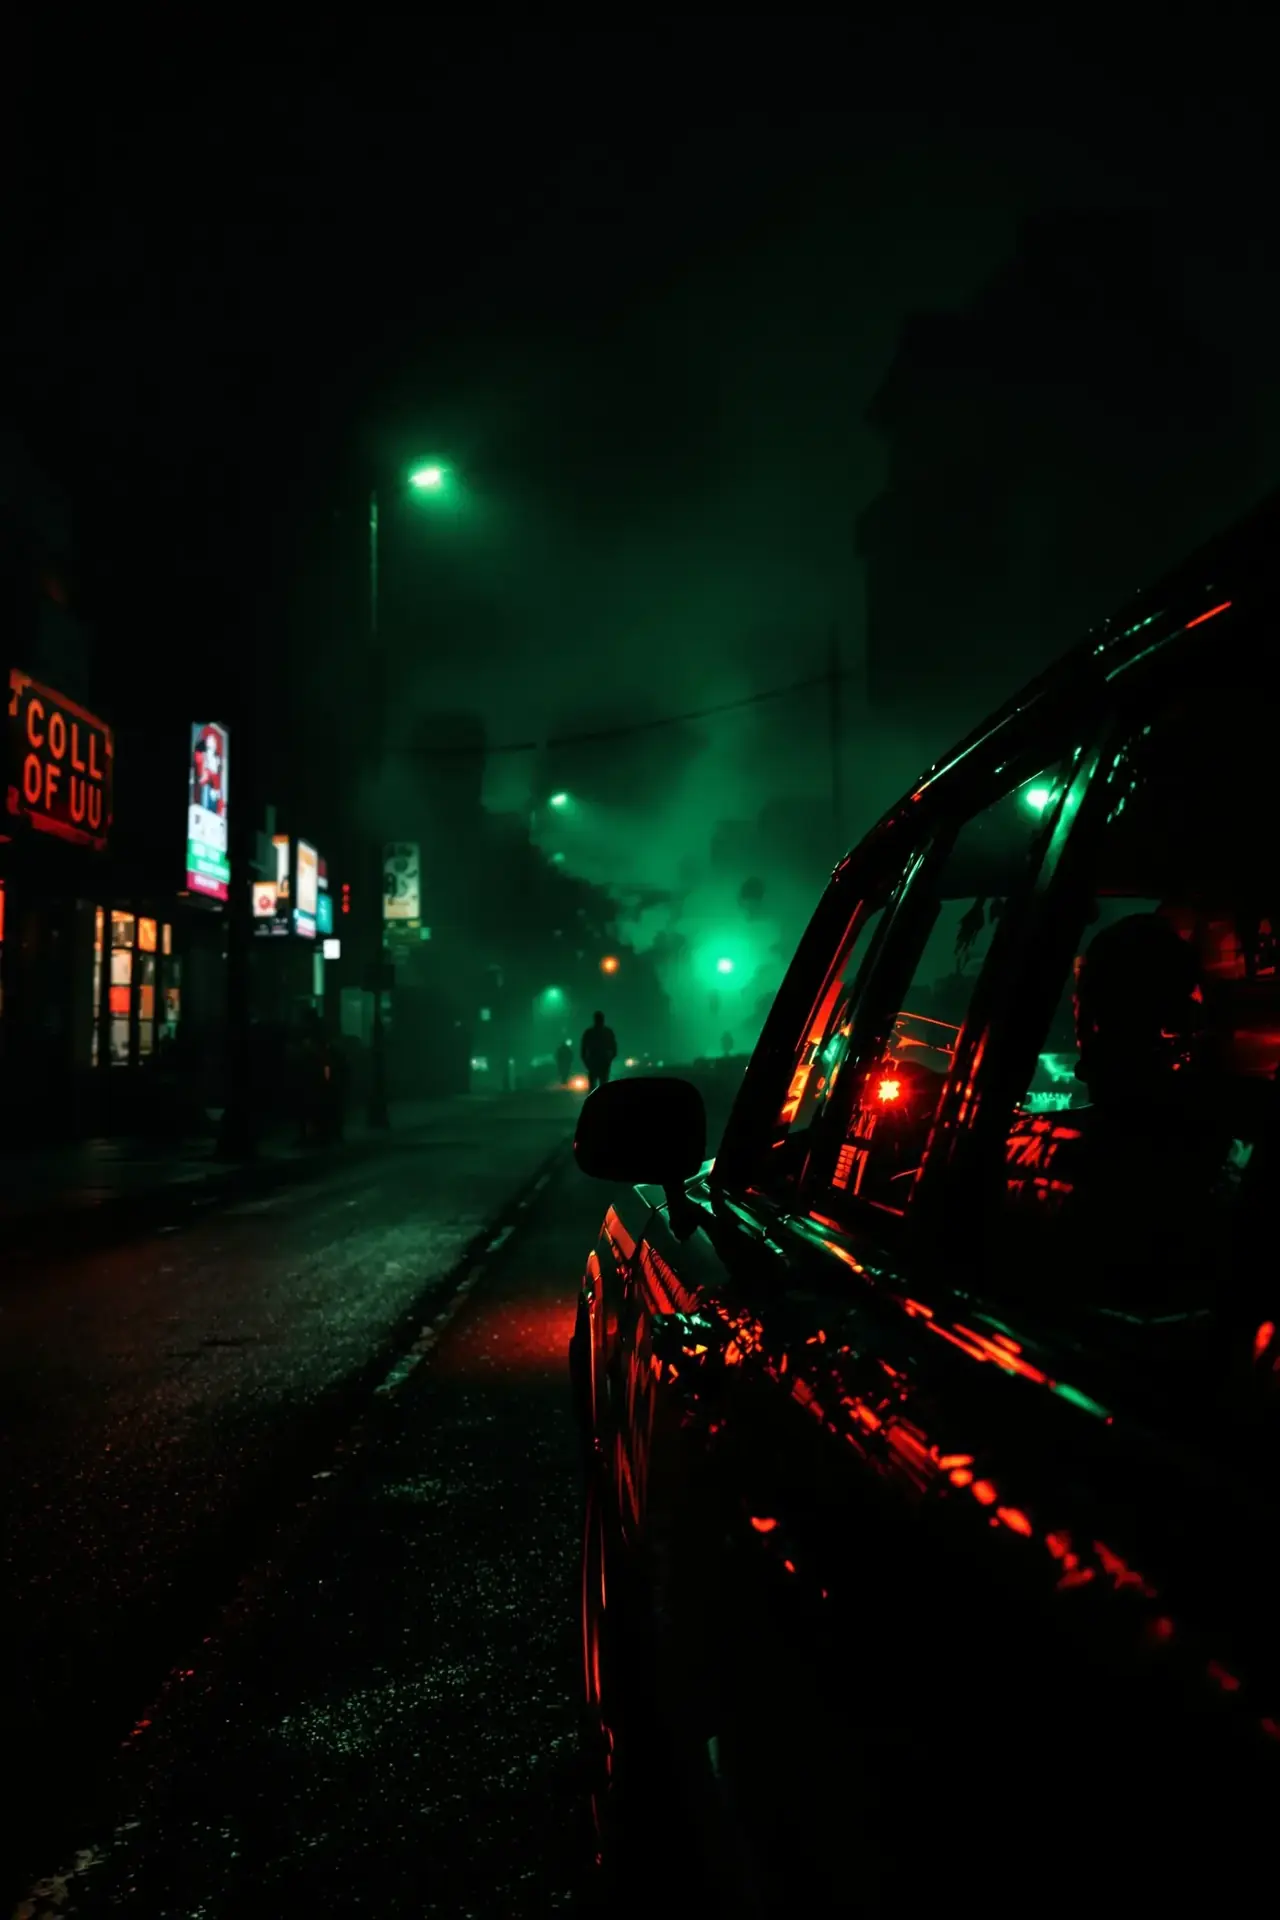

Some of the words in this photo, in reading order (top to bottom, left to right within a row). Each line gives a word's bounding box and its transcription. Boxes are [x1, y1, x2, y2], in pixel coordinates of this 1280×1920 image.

[27, 698, 102, 779] COLL
[24, 754, 61, 810] OF
[70, 776, 102, 829] UU
